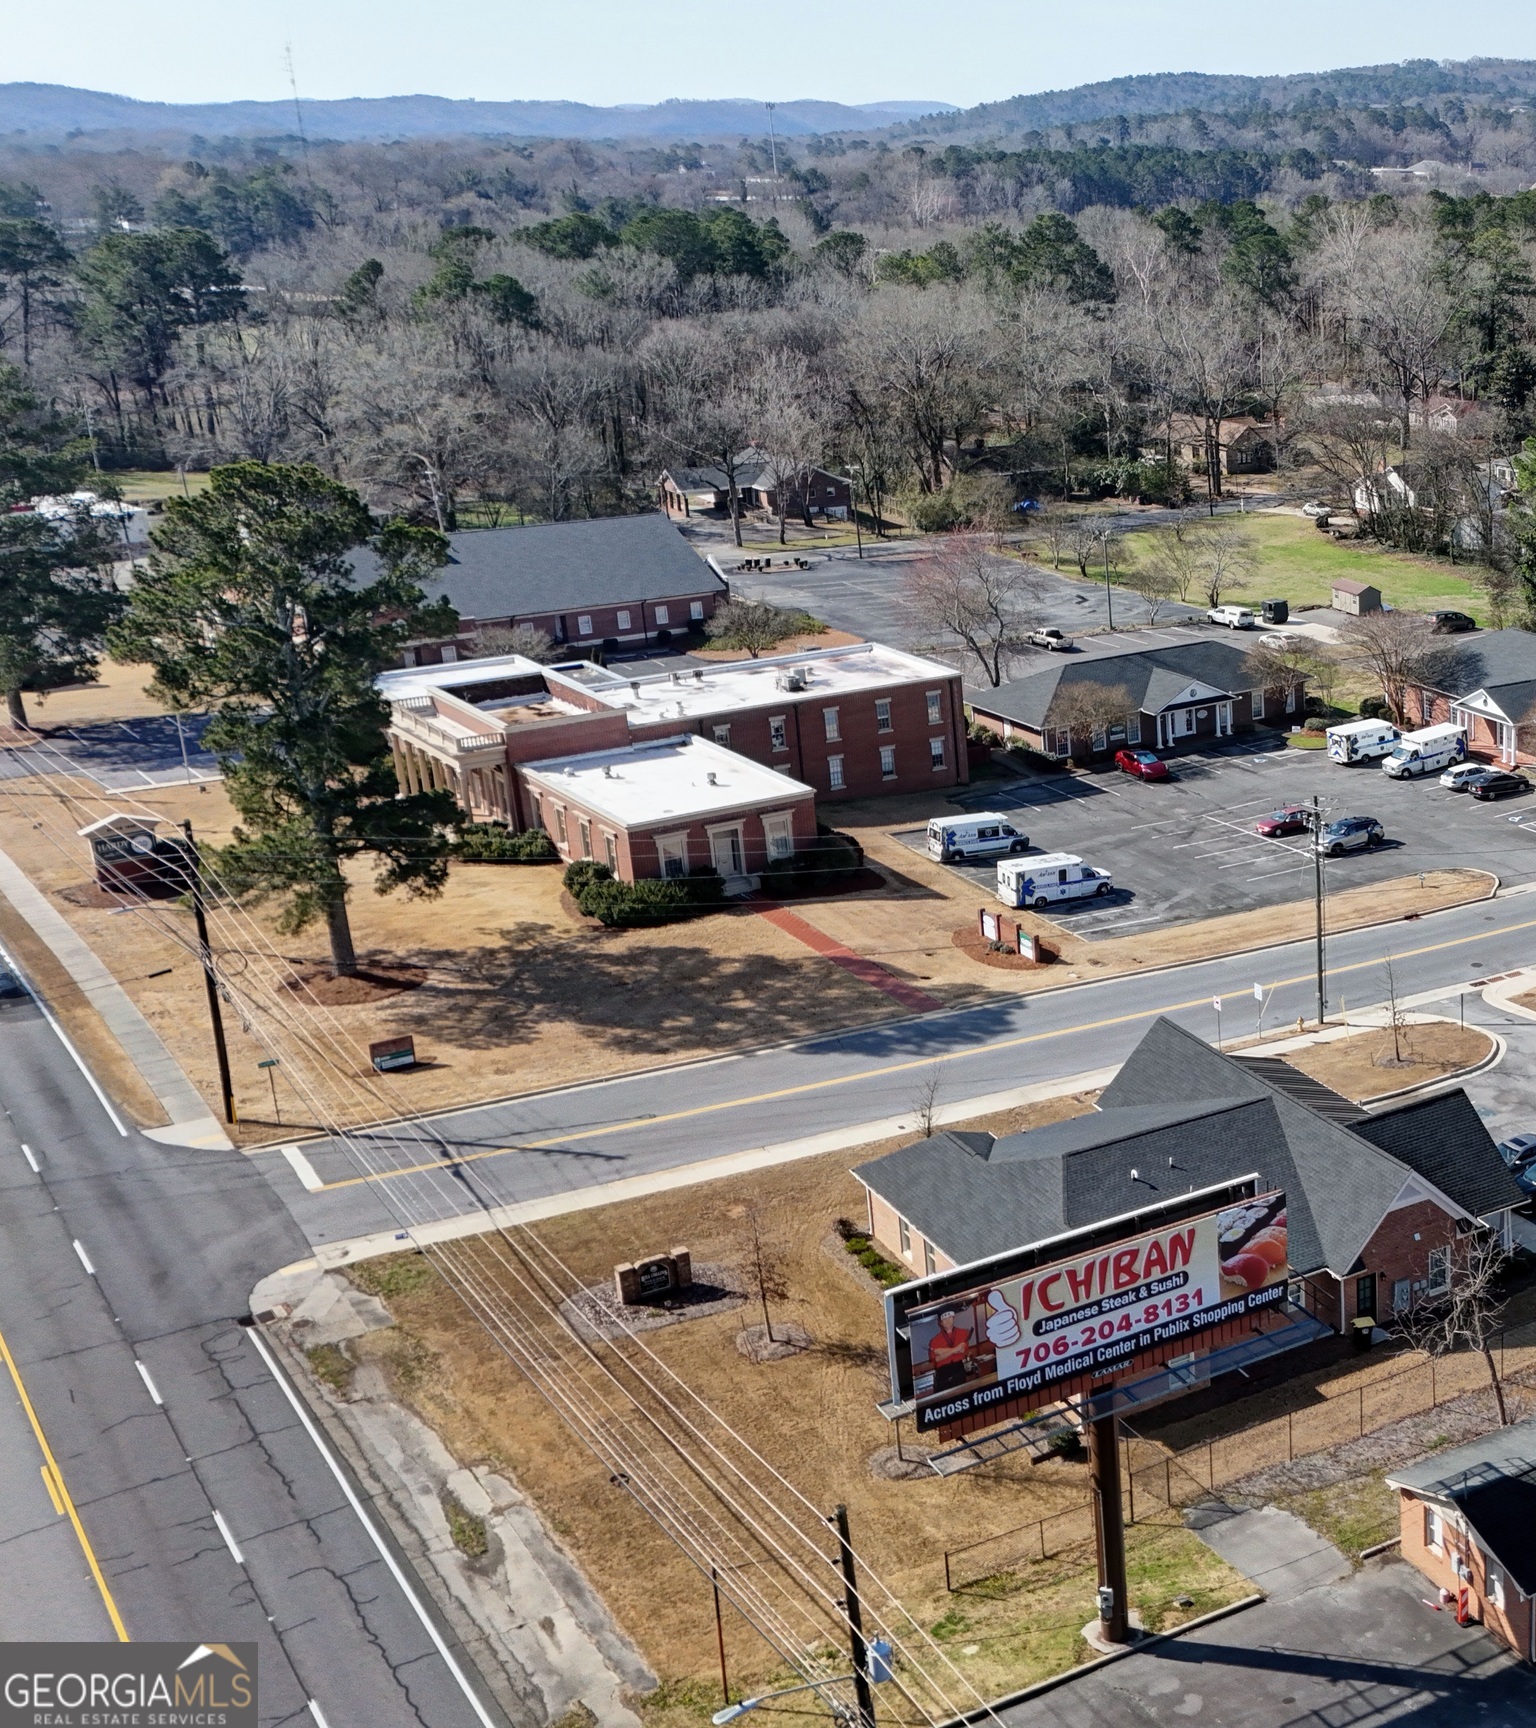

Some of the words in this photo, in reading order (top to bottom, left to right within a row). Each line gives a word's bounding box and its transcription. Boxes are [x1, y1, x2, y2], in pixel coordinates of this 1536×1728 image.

[97, 840, 128, 852] HARDY
[1021, 1227, 1196, 1320] ICHIBAN
[1039, 1302, 1099, 1333] Japanese
[1101, 1291, 1136, 1312] Steak
[1139, 1286, 1148, 1298] &
[1150, 1273, 1184, 1294] Sushi
[924, 1398, 970, 1423] Across
[973, 1386, 1003, 1406] from
[1007, 1370, 1041, 1395] Floyd
[1045, 1352, 1094, 1381] Medical
[1097, 1338, 1136, 1361] Center
[1139, 1333, 1151, 1346] in
[1154, 1320, 1190, 1341] Publix
[1193, 1300, 1245, 1326] Shopping
[1248, 1285, 1284, 1308] Center
[1016, 1288, 1203, 1369] 706-204-8131
[1094, 1361, 1130, 1378] LAMAR
